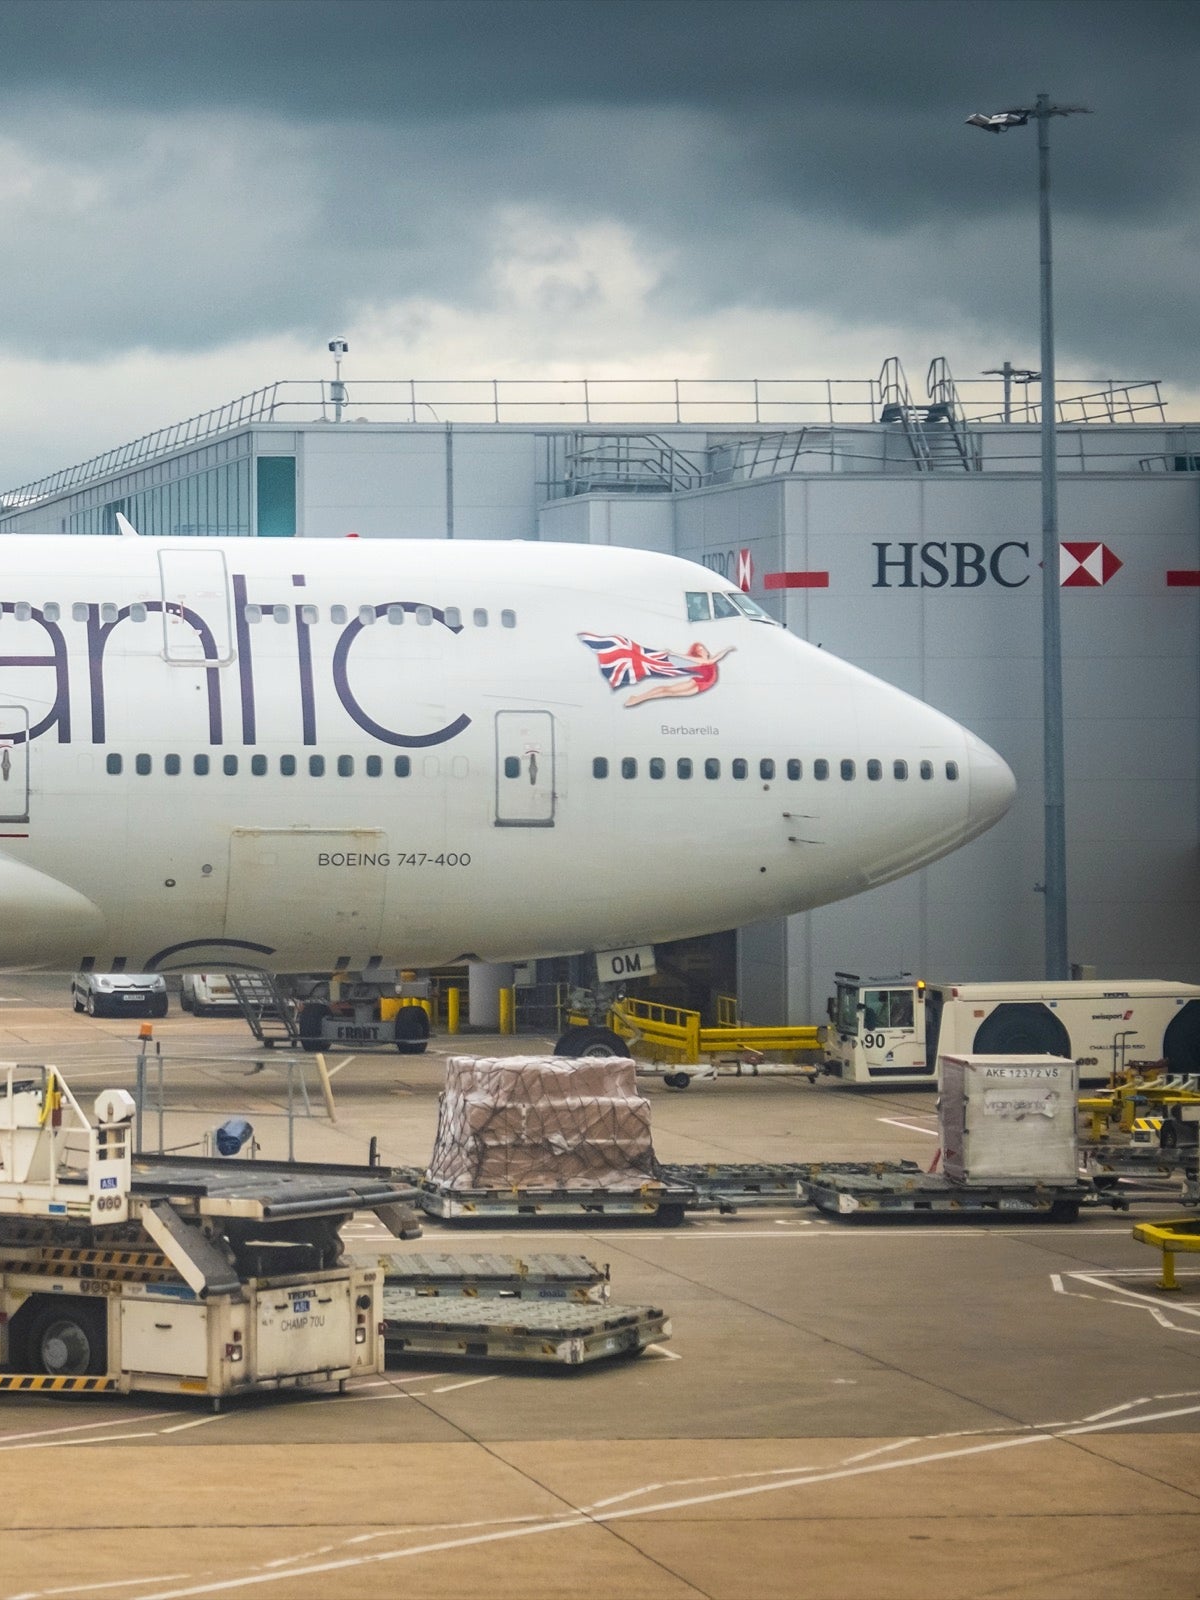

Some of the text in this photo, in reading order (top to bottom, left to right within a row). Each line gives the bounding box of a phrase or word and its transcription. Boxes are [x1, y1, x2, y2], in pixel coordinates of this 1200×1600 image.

[872, 541, 1030, 588] HSBC
[660, 725, 720, 736] Barbarella
[318, 853, 472, 867] BOEING 747-400
[611, 953, 641, 974] OM
[337, 1026, 379, 1040] FRONT
[864, 1033, 886, 1049] 90
[985, 1068, 1059, 1078] AKE 12372 VS
[101, 1178, 117, 1189] ASL
[288, 1289, 318, 1300] TREPEL
[294, 1301, 308, 1312] ASL
[281, 1316, 308, 1332] CHAMP
